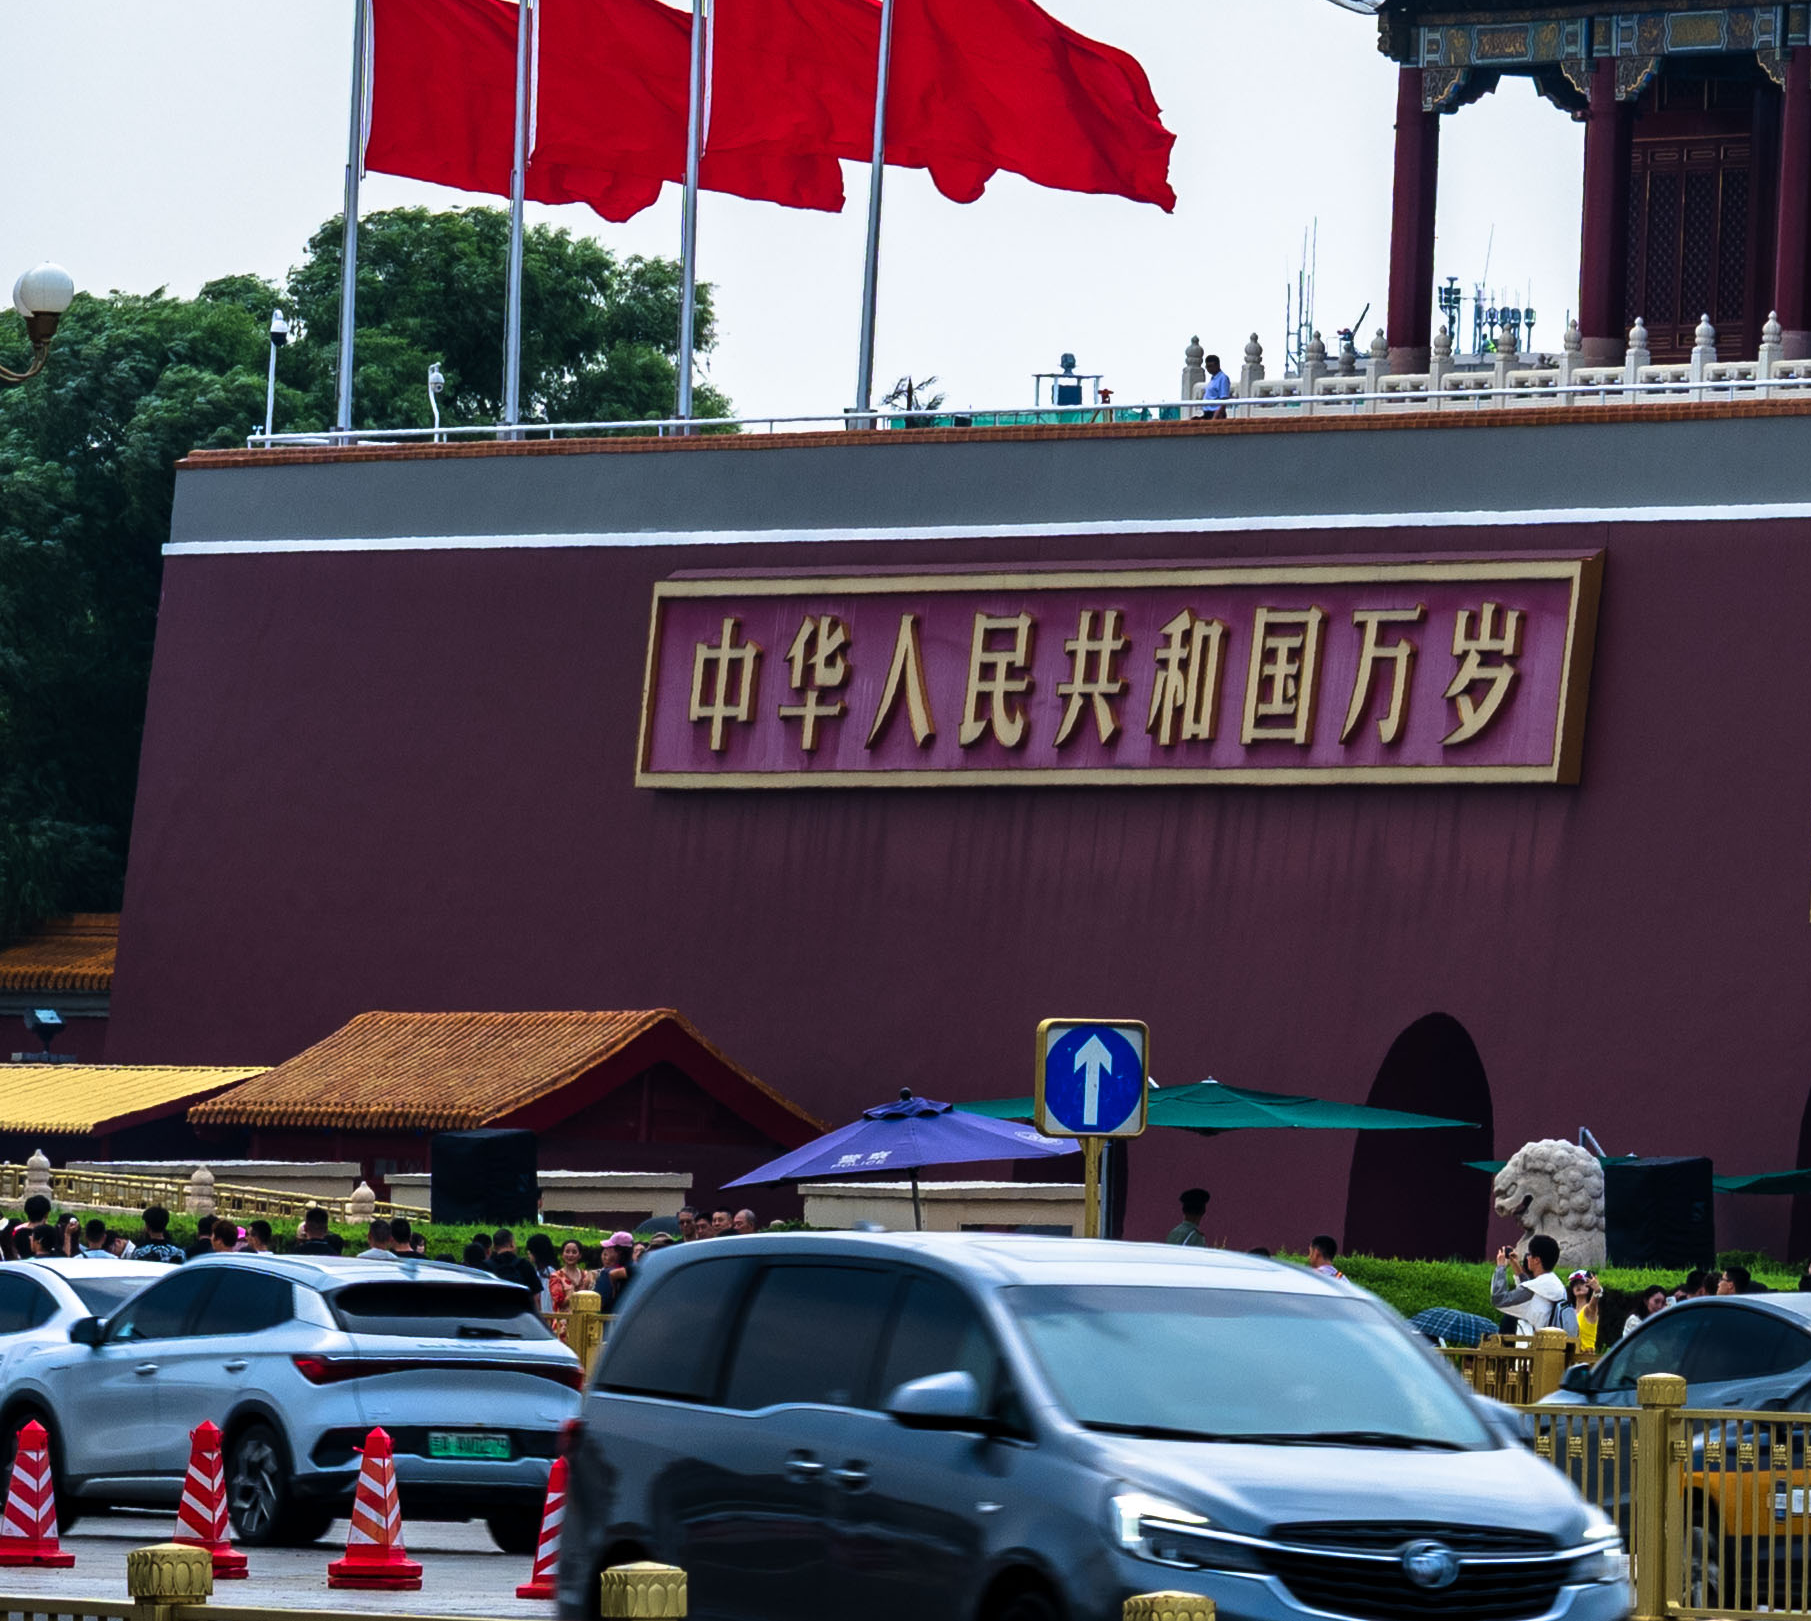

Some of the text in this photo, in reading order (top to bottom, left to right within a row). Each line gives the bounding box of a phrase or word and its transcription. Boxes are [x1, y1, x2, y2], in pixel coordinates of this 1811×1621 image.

[688, 601, 1526, 754] 中华人民共和国万岁
